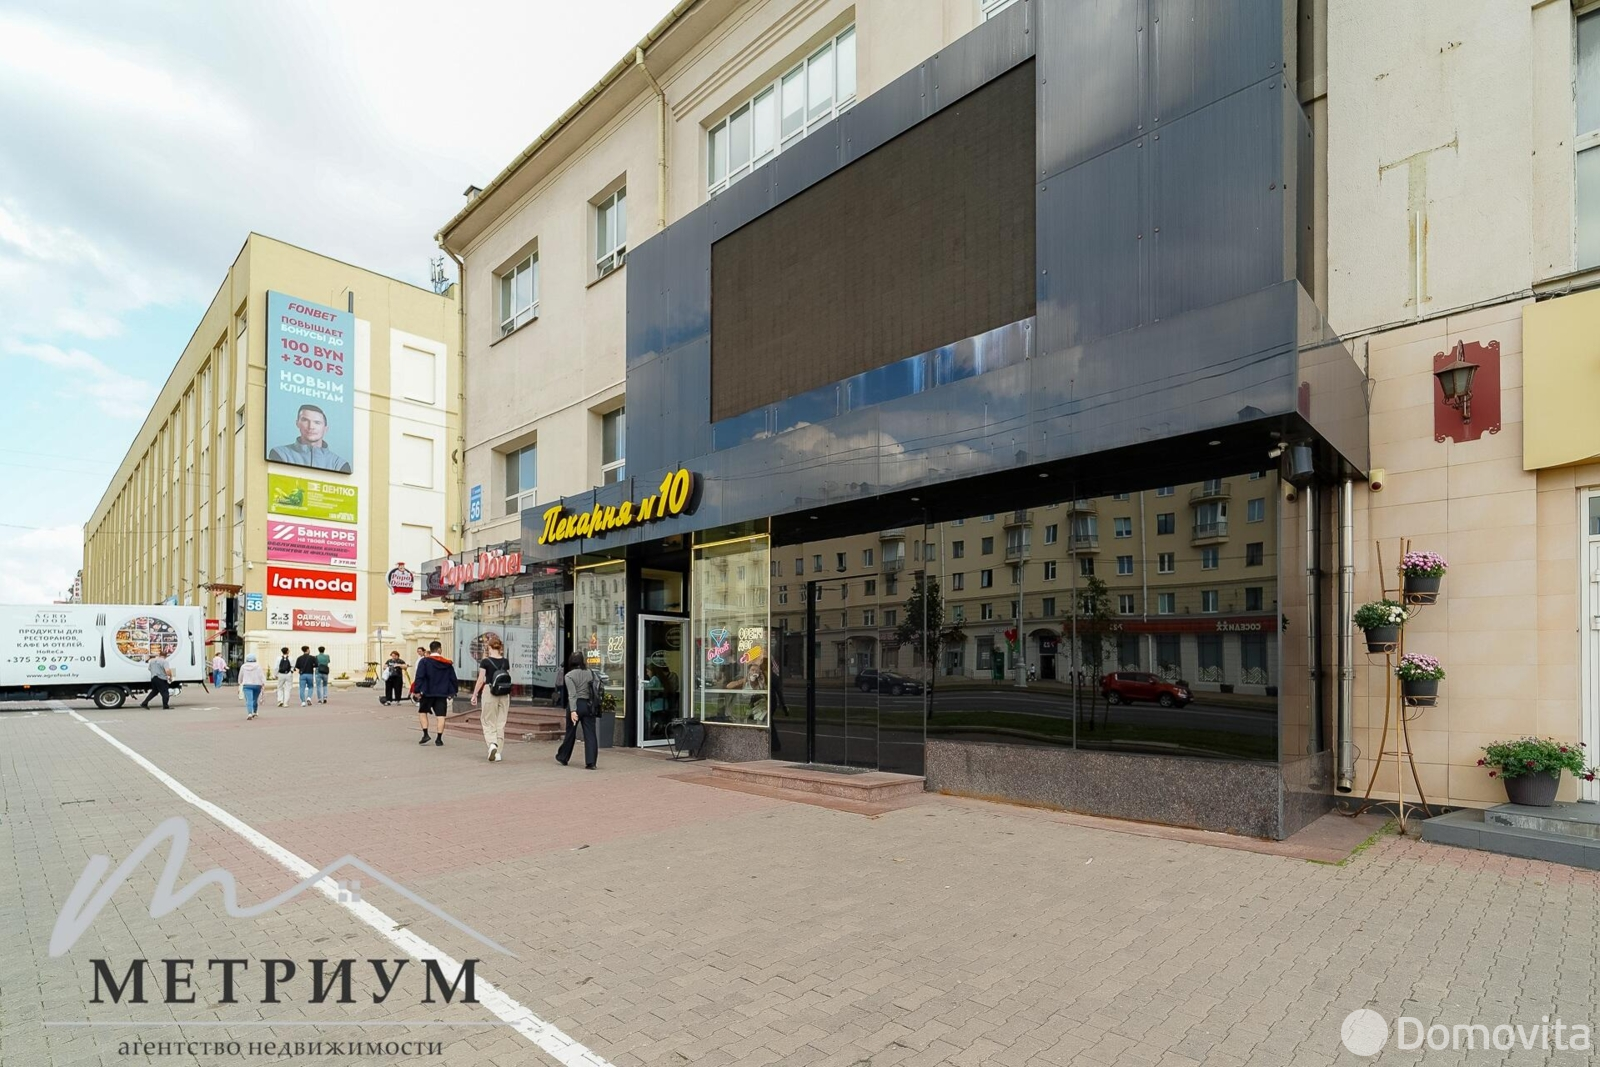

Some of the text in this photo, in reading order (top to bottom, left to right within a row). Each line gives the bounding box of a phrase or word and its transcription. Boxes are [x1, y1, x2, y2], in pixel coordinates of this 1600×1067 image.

[288, 303, 337, 322] FONBET
[281, 316, 343, 337] ПОВЫШАЕТ
[281, 324, 343, 346] БОНУСЫ ДО
[281, 338, 343, 362] 100 BYN
[293, 355, 323, 371] 300
[327, 363, 343, 376] FS
[280, 370, 343, 393] НОВЫМ
[280, 382, 343, 403] КЛИЕНТАМ
[471, 501, 480, 519] 56
[298, 526, 355, 541] Банк РРБ
[538, 503, 632, 545] Пекарня
[273, 573, 353, 593] lamoda
[440, 560, 474, 591] Papa
[247, 601, 262, 610] 58
[297, 613, 331, 621] ОДЕЖДА
[608, 636, 624, 652] 8-22
